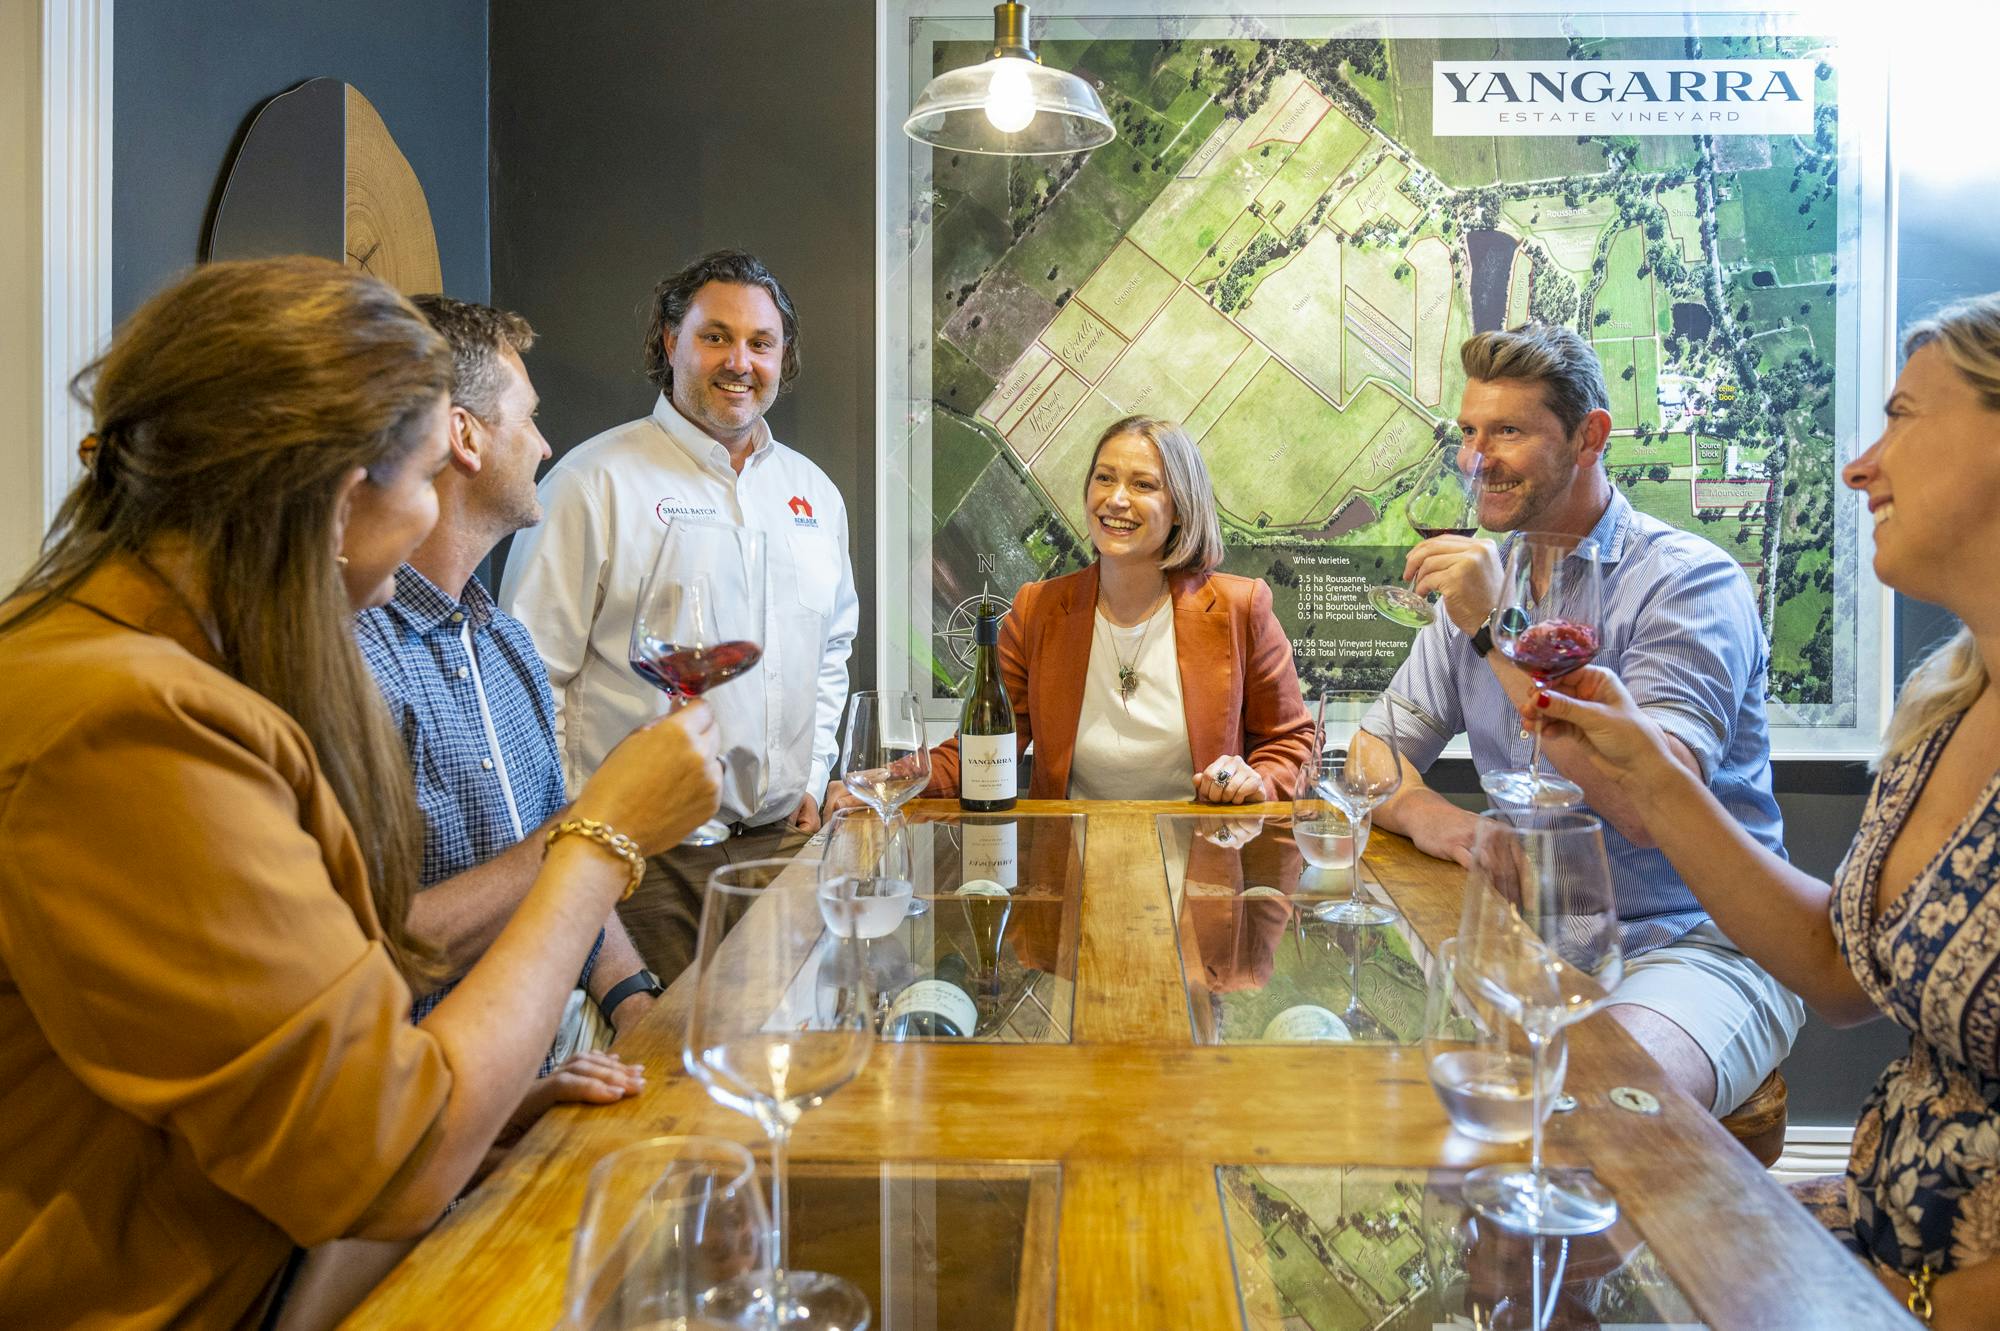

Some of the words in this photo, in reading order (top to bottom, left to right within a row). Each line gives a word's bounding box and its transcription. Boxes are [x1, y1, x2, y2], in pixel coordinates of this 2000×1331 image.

[1441, 70, 1804, 104] YANGARRA
[1498, 111, 1597, 123] ESTATE
[1611, 111, 1741, 123] VINEYARD
[1546, 208, 1588, 218] Roussanne
[1016, 383, 1042, 412] Grenache
[1269, 441, 1289, 464] Shiraz
[1633, 446, 1657, 455] Shiraz
[1701, 450, 1719, 458] block
[662, 507, 690, 515] SMALL
[978, 553, 996, 573] N
[1293, 556, 1316, 565] White
[1318, 556, 1350, 565] Varieties
[1298, 574, 1312, 583] 3.5
[1313, 574, 1323, 583] ha
[1325, 575, 1367, 583] Roussanne
[1298, 584, 1312, 592] 1.6
[1313, 584, 1323, 592] ha
[1325, 584, 1362, 592] Grenache
[1298, 593, 1312, 602] 1.0
[1313, 593, 1323, 601] ha
[1325, 593, 1357, 601] Clairette
[1297, 602, 1312, 611] 0.6
[1313, 602, 1323, 611] ha
[1297, 612, 1312, 620] 0.5
[1313, 612, 1323, 620] ha
[1325, 612, 1354, 622] Picpoul
[1356, 612, 1378, 620] blanc
[1292, 639, 1316, 648] 87.56
[1318, 639, 1336, 648] Total
[1338, 639, 1373, 650] Vineyard
[1375, 639, 1409, 648] Hectares
[1318, 648, 1336, 657] Total
[1338, 648, 1373, 659] Vineyard
[1375, 648, 1395, 657] Acres
[968, 757, 1012, 765] YANGARRA
